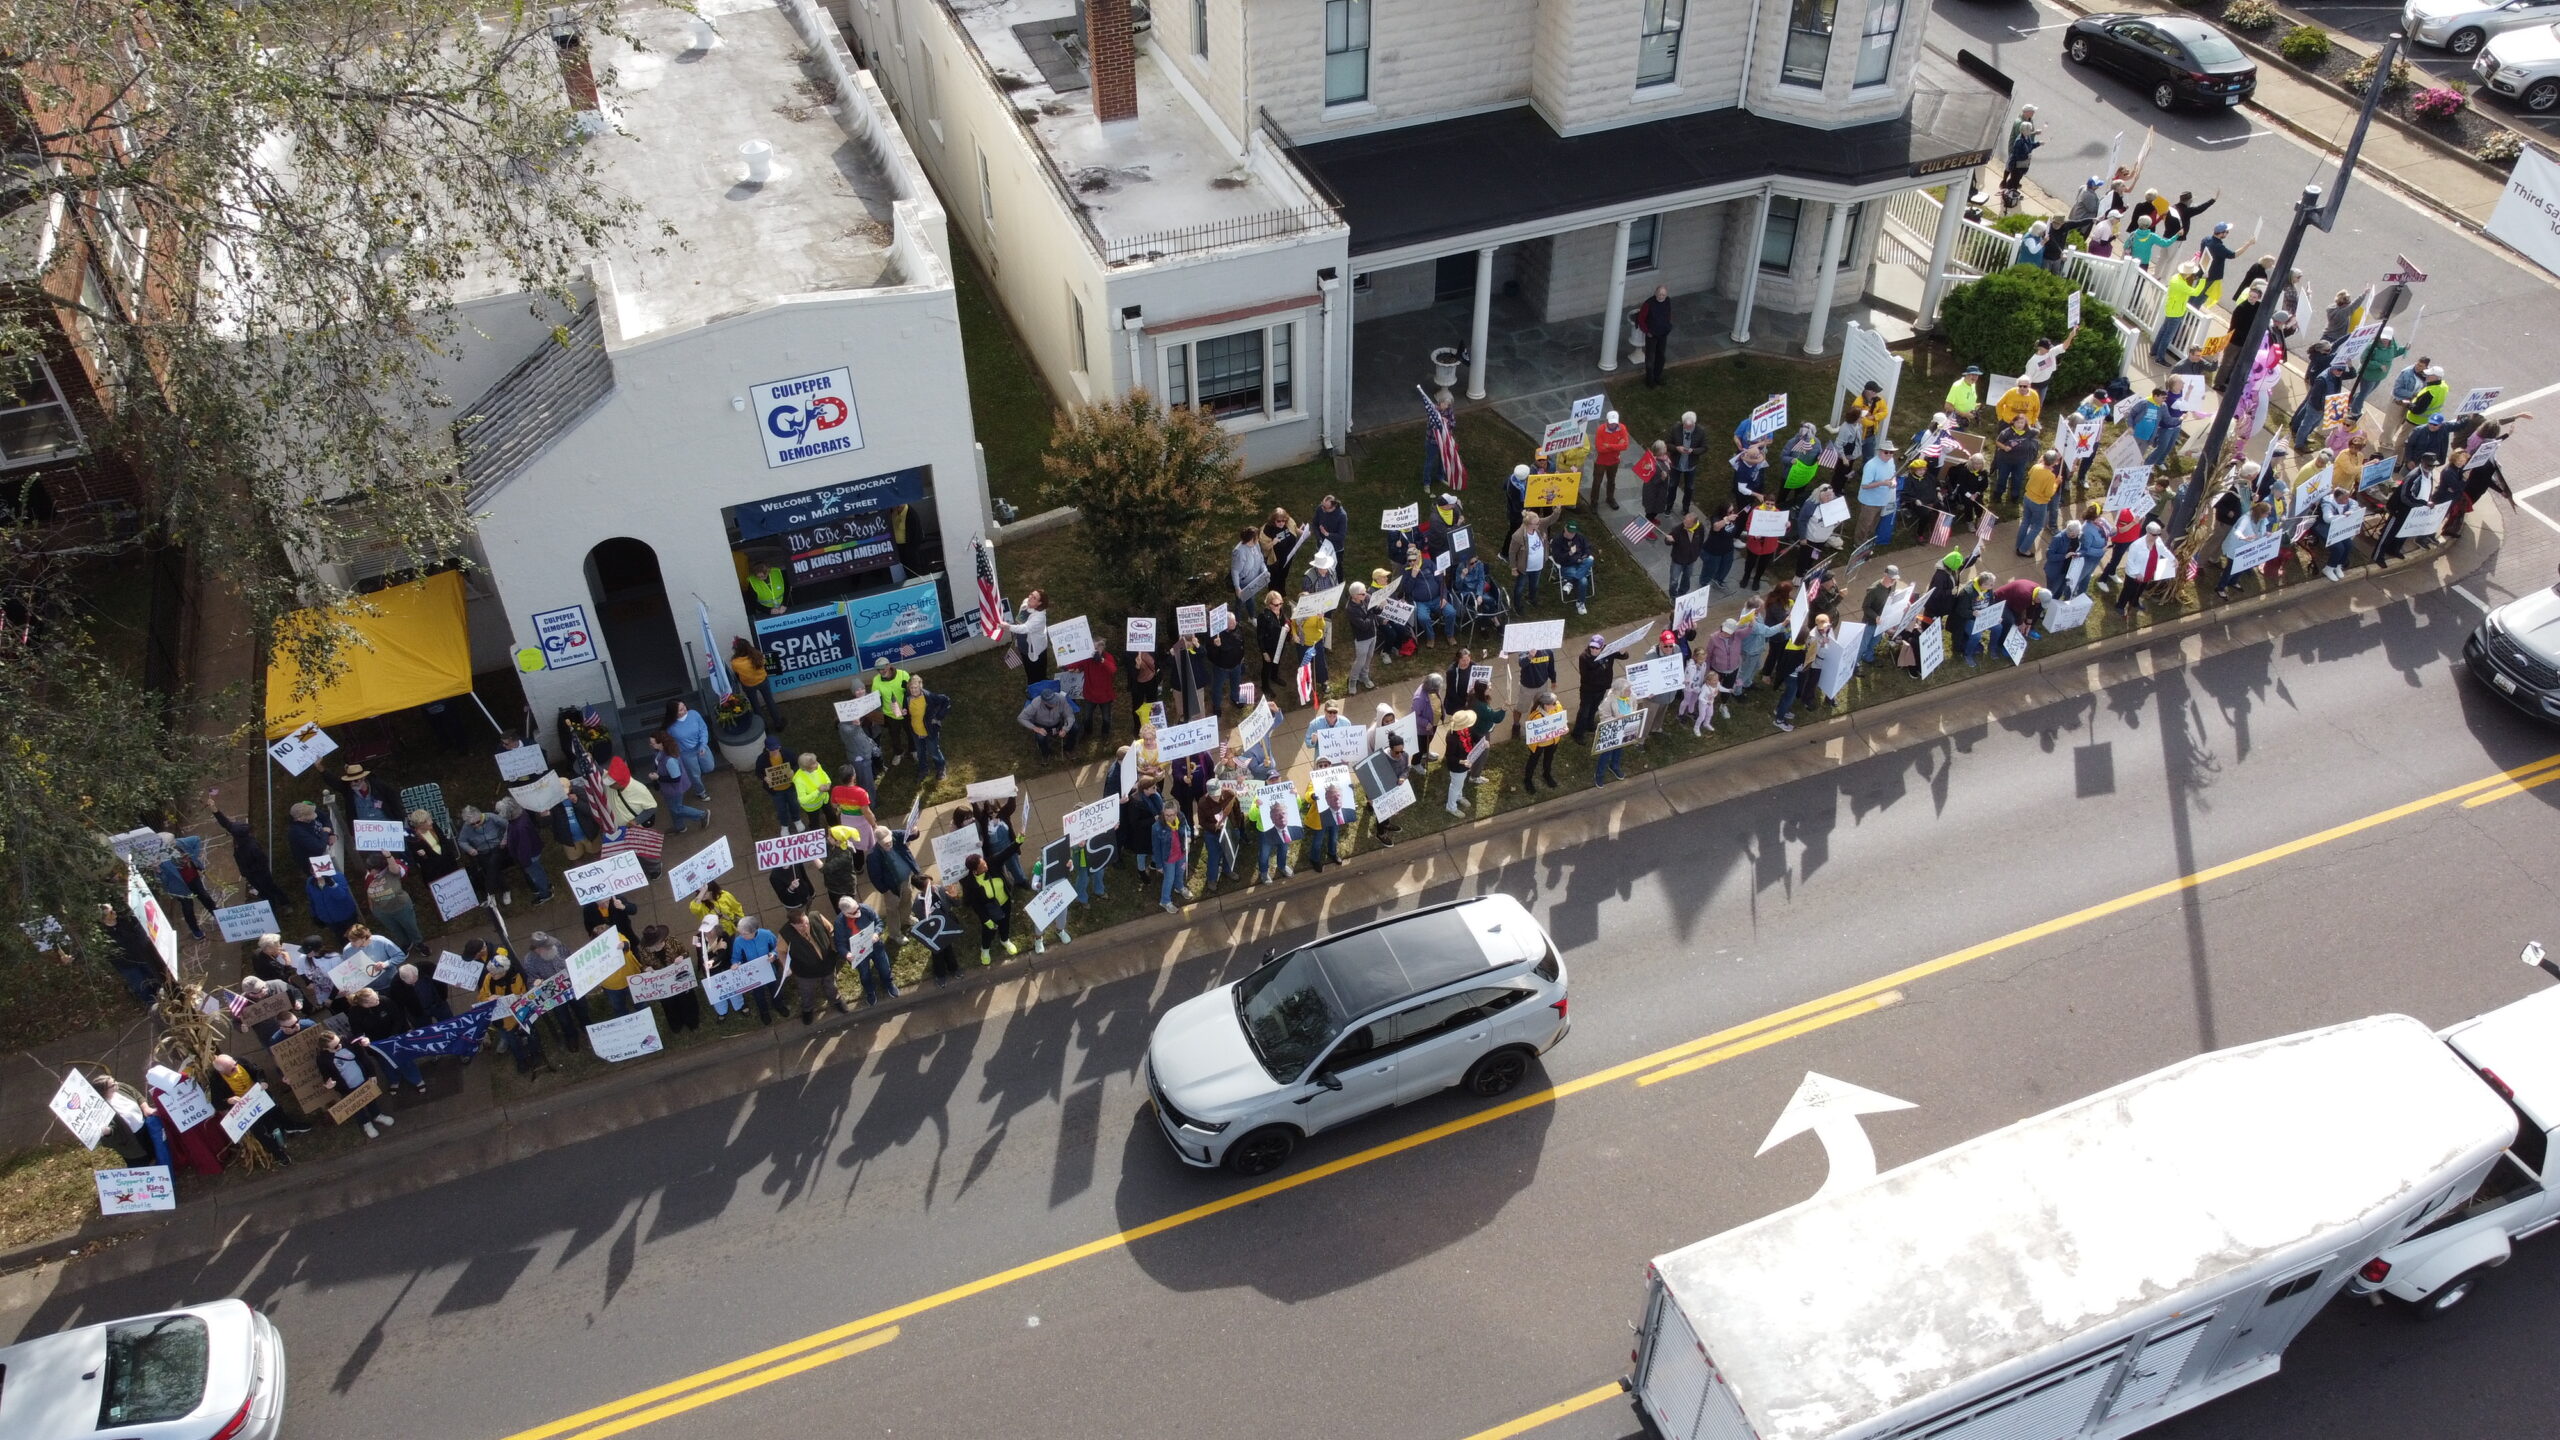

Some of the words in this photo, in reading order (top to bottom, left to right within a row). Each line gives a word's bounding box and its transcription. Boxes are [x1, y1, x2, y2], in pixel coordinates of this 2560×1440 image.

[1920, 153, 1983, 174] CULPEPER
[2512, 181, 2543, 208] Third
[2351, 325, 2379, 338] LOVE
[771, 376, 832, 399] CULPEPER
[2481, 389, 2500, 400] MAD
[1581, 399, 1595, 408] NO
[2458, 397, 2494, 414] KINGS
[1574, 405, 1600, 418] KINGS
[1753, 411, 1785, 437] VOTE
[779, 436, 851, 462] DEMOCRATS
[1545, 432, 1583, 452] BETRAYAL!
[760, 495, 812, 513] WELCOME
[816, 491, 832, 500] TO
[836, 475, 897, 496] DEMOCRACY
[789, 513, 806, 524] ON
[811, 507, 839, 519] MAIN
[843, 498, 878, 512] STREET
[1382, 518, 1417, 530] DEMOCRACY
[788, 533, 814, 552] We
[813, 526, 841, 545] The
[843, 515, 888, 542] People
[793, 561, 809, 574] NO
[810, 554, 843, 569] KINGS
[843, 550, 853, 562] IN
[853, 540, 894, 559] AMERICA
[1384, 603, 1398, 614] OUR
[543, 612, 575, 625] CULPEPER
[894, 614, 929, 629] Virginia
[542, 619, 581, 634] DEMOCRATS
[770, 629, 834, 658] SPAN
[777, 646, 843, 672] BERGER
[774, 675, 795, 688] FOR
[798, 662, 853, 683] GOVERNOR
[1471, 670, 1488, 678] OFF!
[1526, 719, 1550, 729] Checks
[1599, 721, 1619, 732] GOLD
[1599, 729, 1612, 738] DO
[1611, 724, 1627, 736] NOT
[1169, 727, 1204, 742] VOTE
[1321, 730, 1335, 739] We
[1529, 735, 1542, 743] NO
[1597, 733, 1619, 743] MAKE
[274, 742, 294, 758] NO
[300, 744, 309, 752] IN
[1162, 738, 1196, 751] NOVEMBER
[1323, 741, 1340, 752] with
[1345, 739, 1359, 748] the
[1602, 739, 1620, 750] KING
[1311, 765, 1347, 778] FAUX-KING
[1256, 782, 1294, 796] FAUX-KING
[1268, 792, 1283, 800] JOKE
[1063, 814, 1077, 826] NO
[1077, 799, 1117, 819] PROJECT
[355, 824, 384, 833] DEFEND
[1078, 814, 1104, 830] 2025
[356, 836, 404, 849] Constitution
[756, 840, 772, 853] NO
[775, 830, 826, 849] OLIGARCHS
[758, 851, 780, 868] NO
[781, 841, 826, 862] KINGS
[611, 856, 637, 872] ICE
[574, 937, 610, 970] HONK
[629, 964, 689, 986] Oppression
[715, 975, 727, 983] NO
[731, 965, 757, 978] KINGS
[670, 979, 697, 994] Fear
[719, 978, 756, 995] AMERICA
[71, 1095, 98, 1132] AMERICA
[181, 1104, 195, 1116] NO
[230, 1094, 254, 1119] HONK
[181, 1109, 208, 1127] KINGS
[237, 1104, 264, 1132] BLUE
[111, 1170, 127, 1179] Who
[146, 1185, 165, 1194] King
